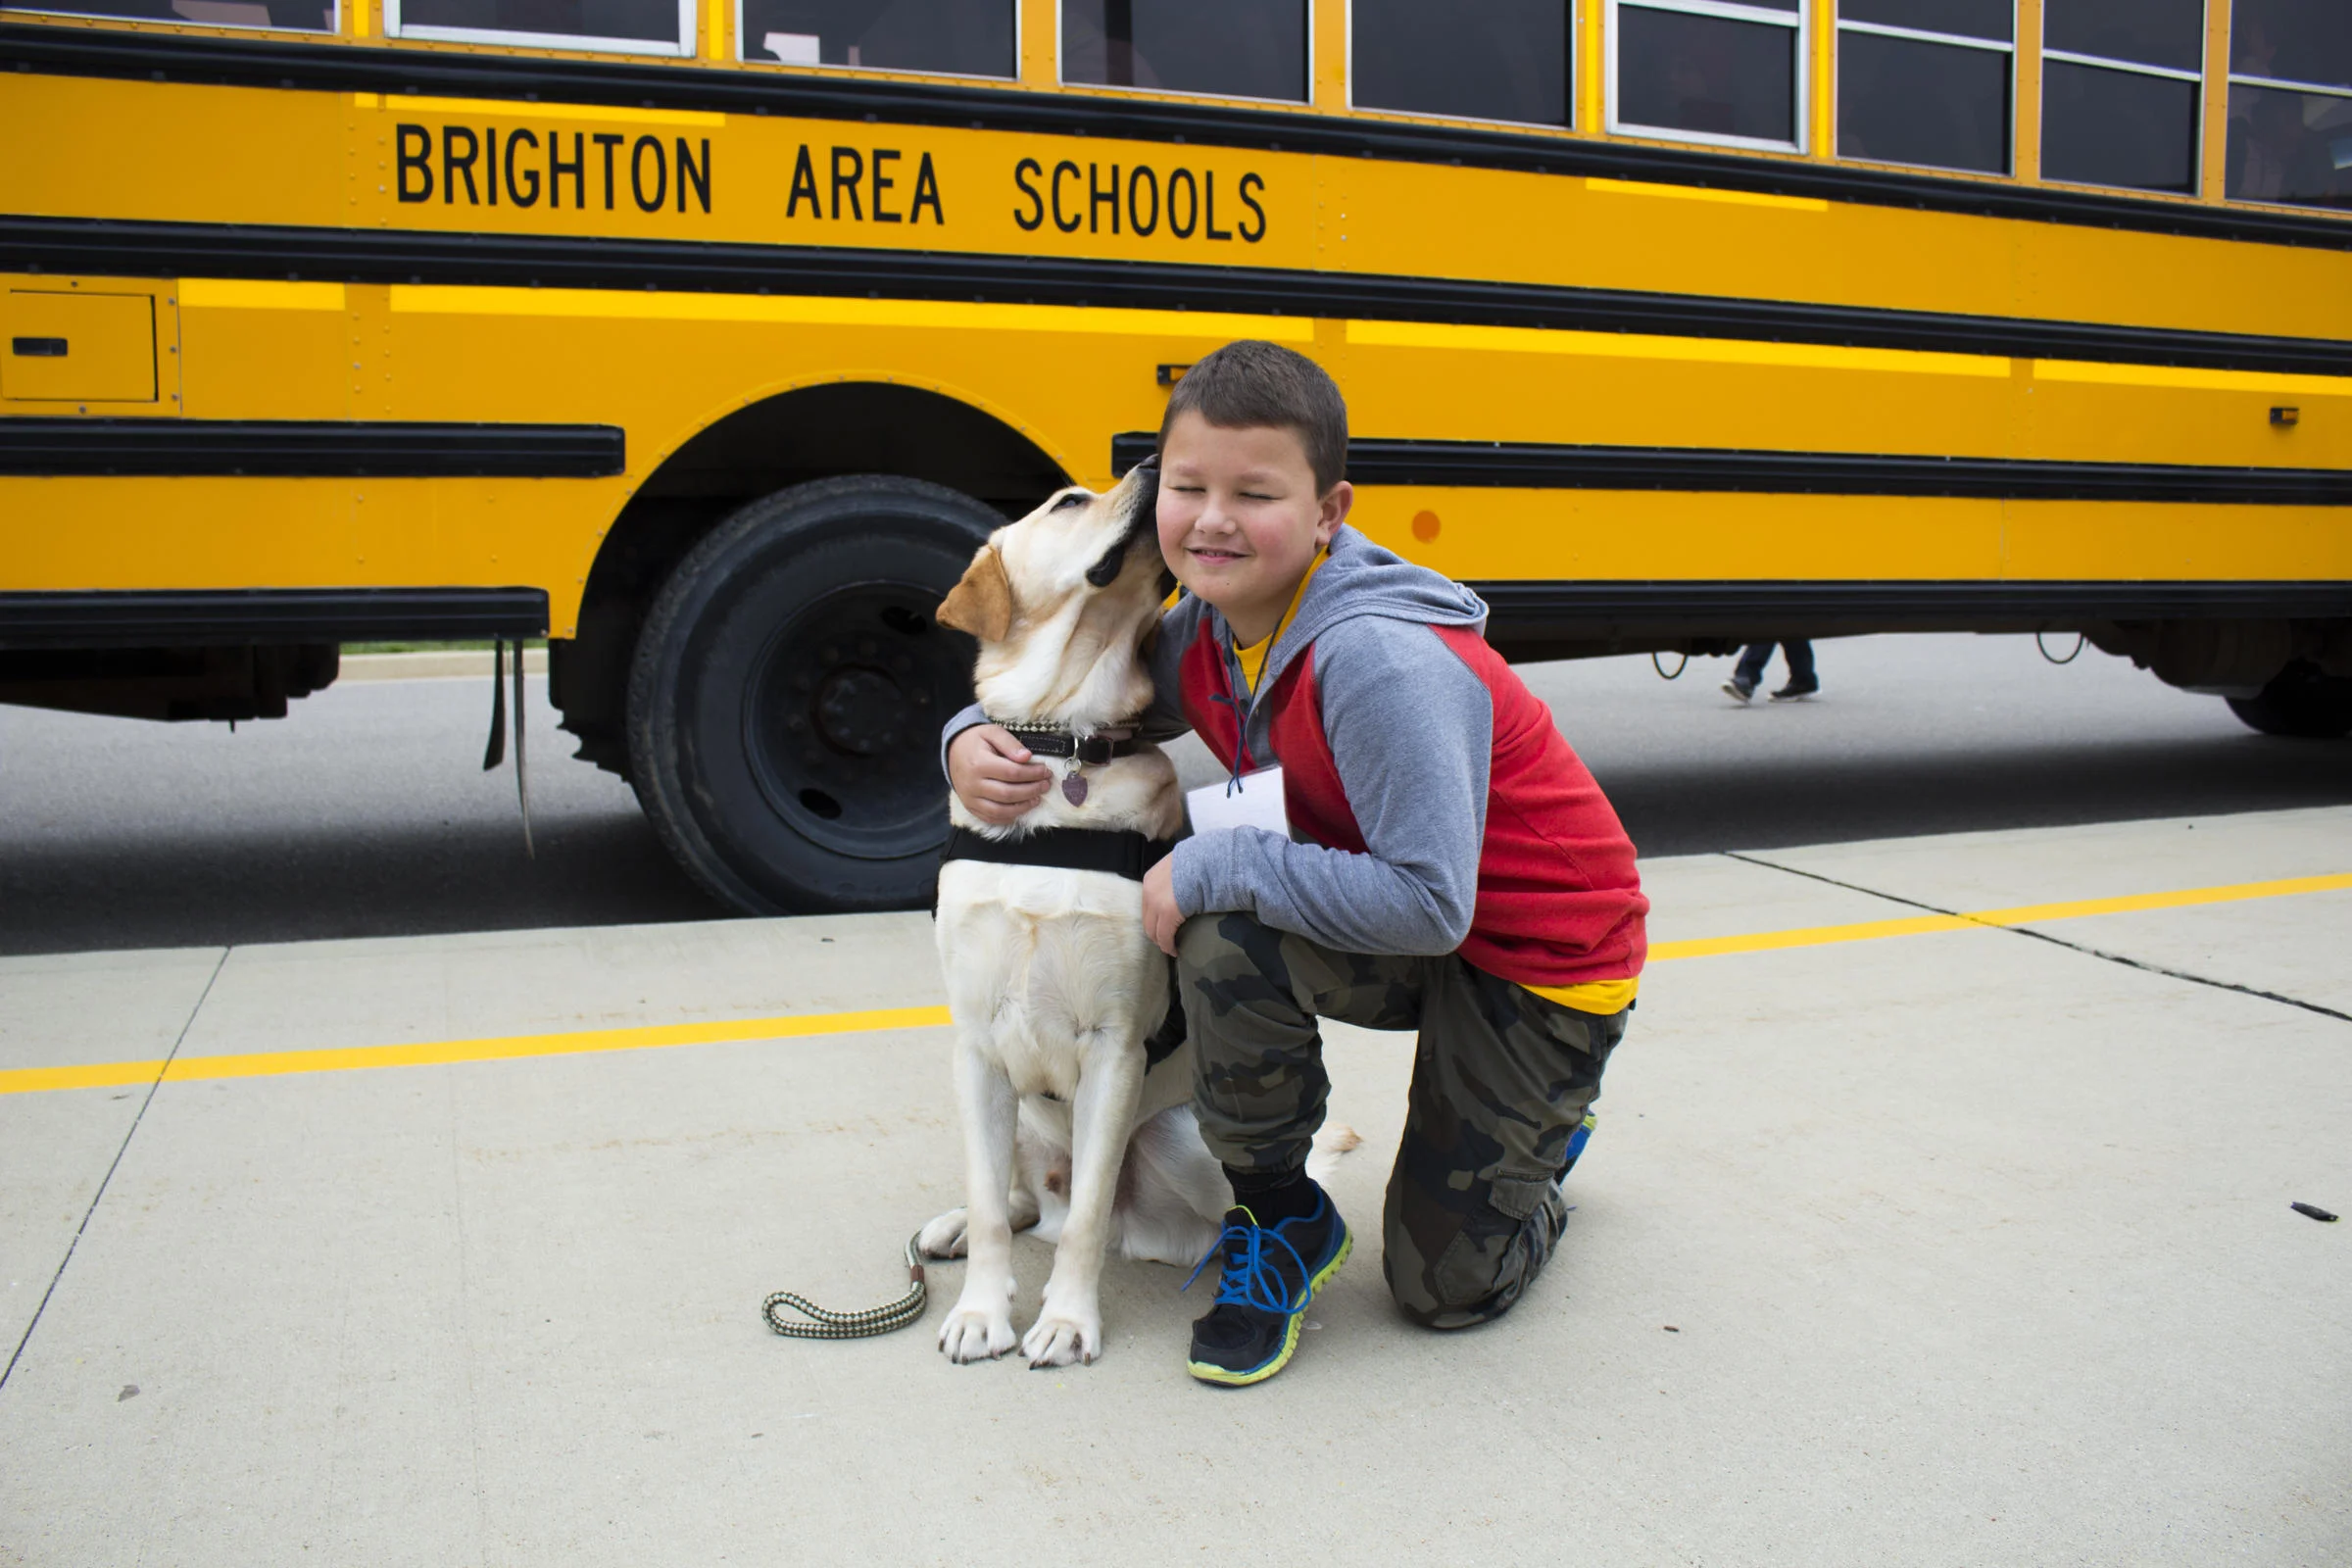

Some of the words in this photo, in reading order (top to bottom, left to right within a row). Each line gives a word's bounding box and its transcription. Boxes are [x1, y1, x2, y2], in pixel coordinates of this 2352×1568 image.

[397, 123, 711, 215] BRIGHTON
[787, 145, 945, 225] AREA
[1014, 158, 1266, 244] SCHOOLS
